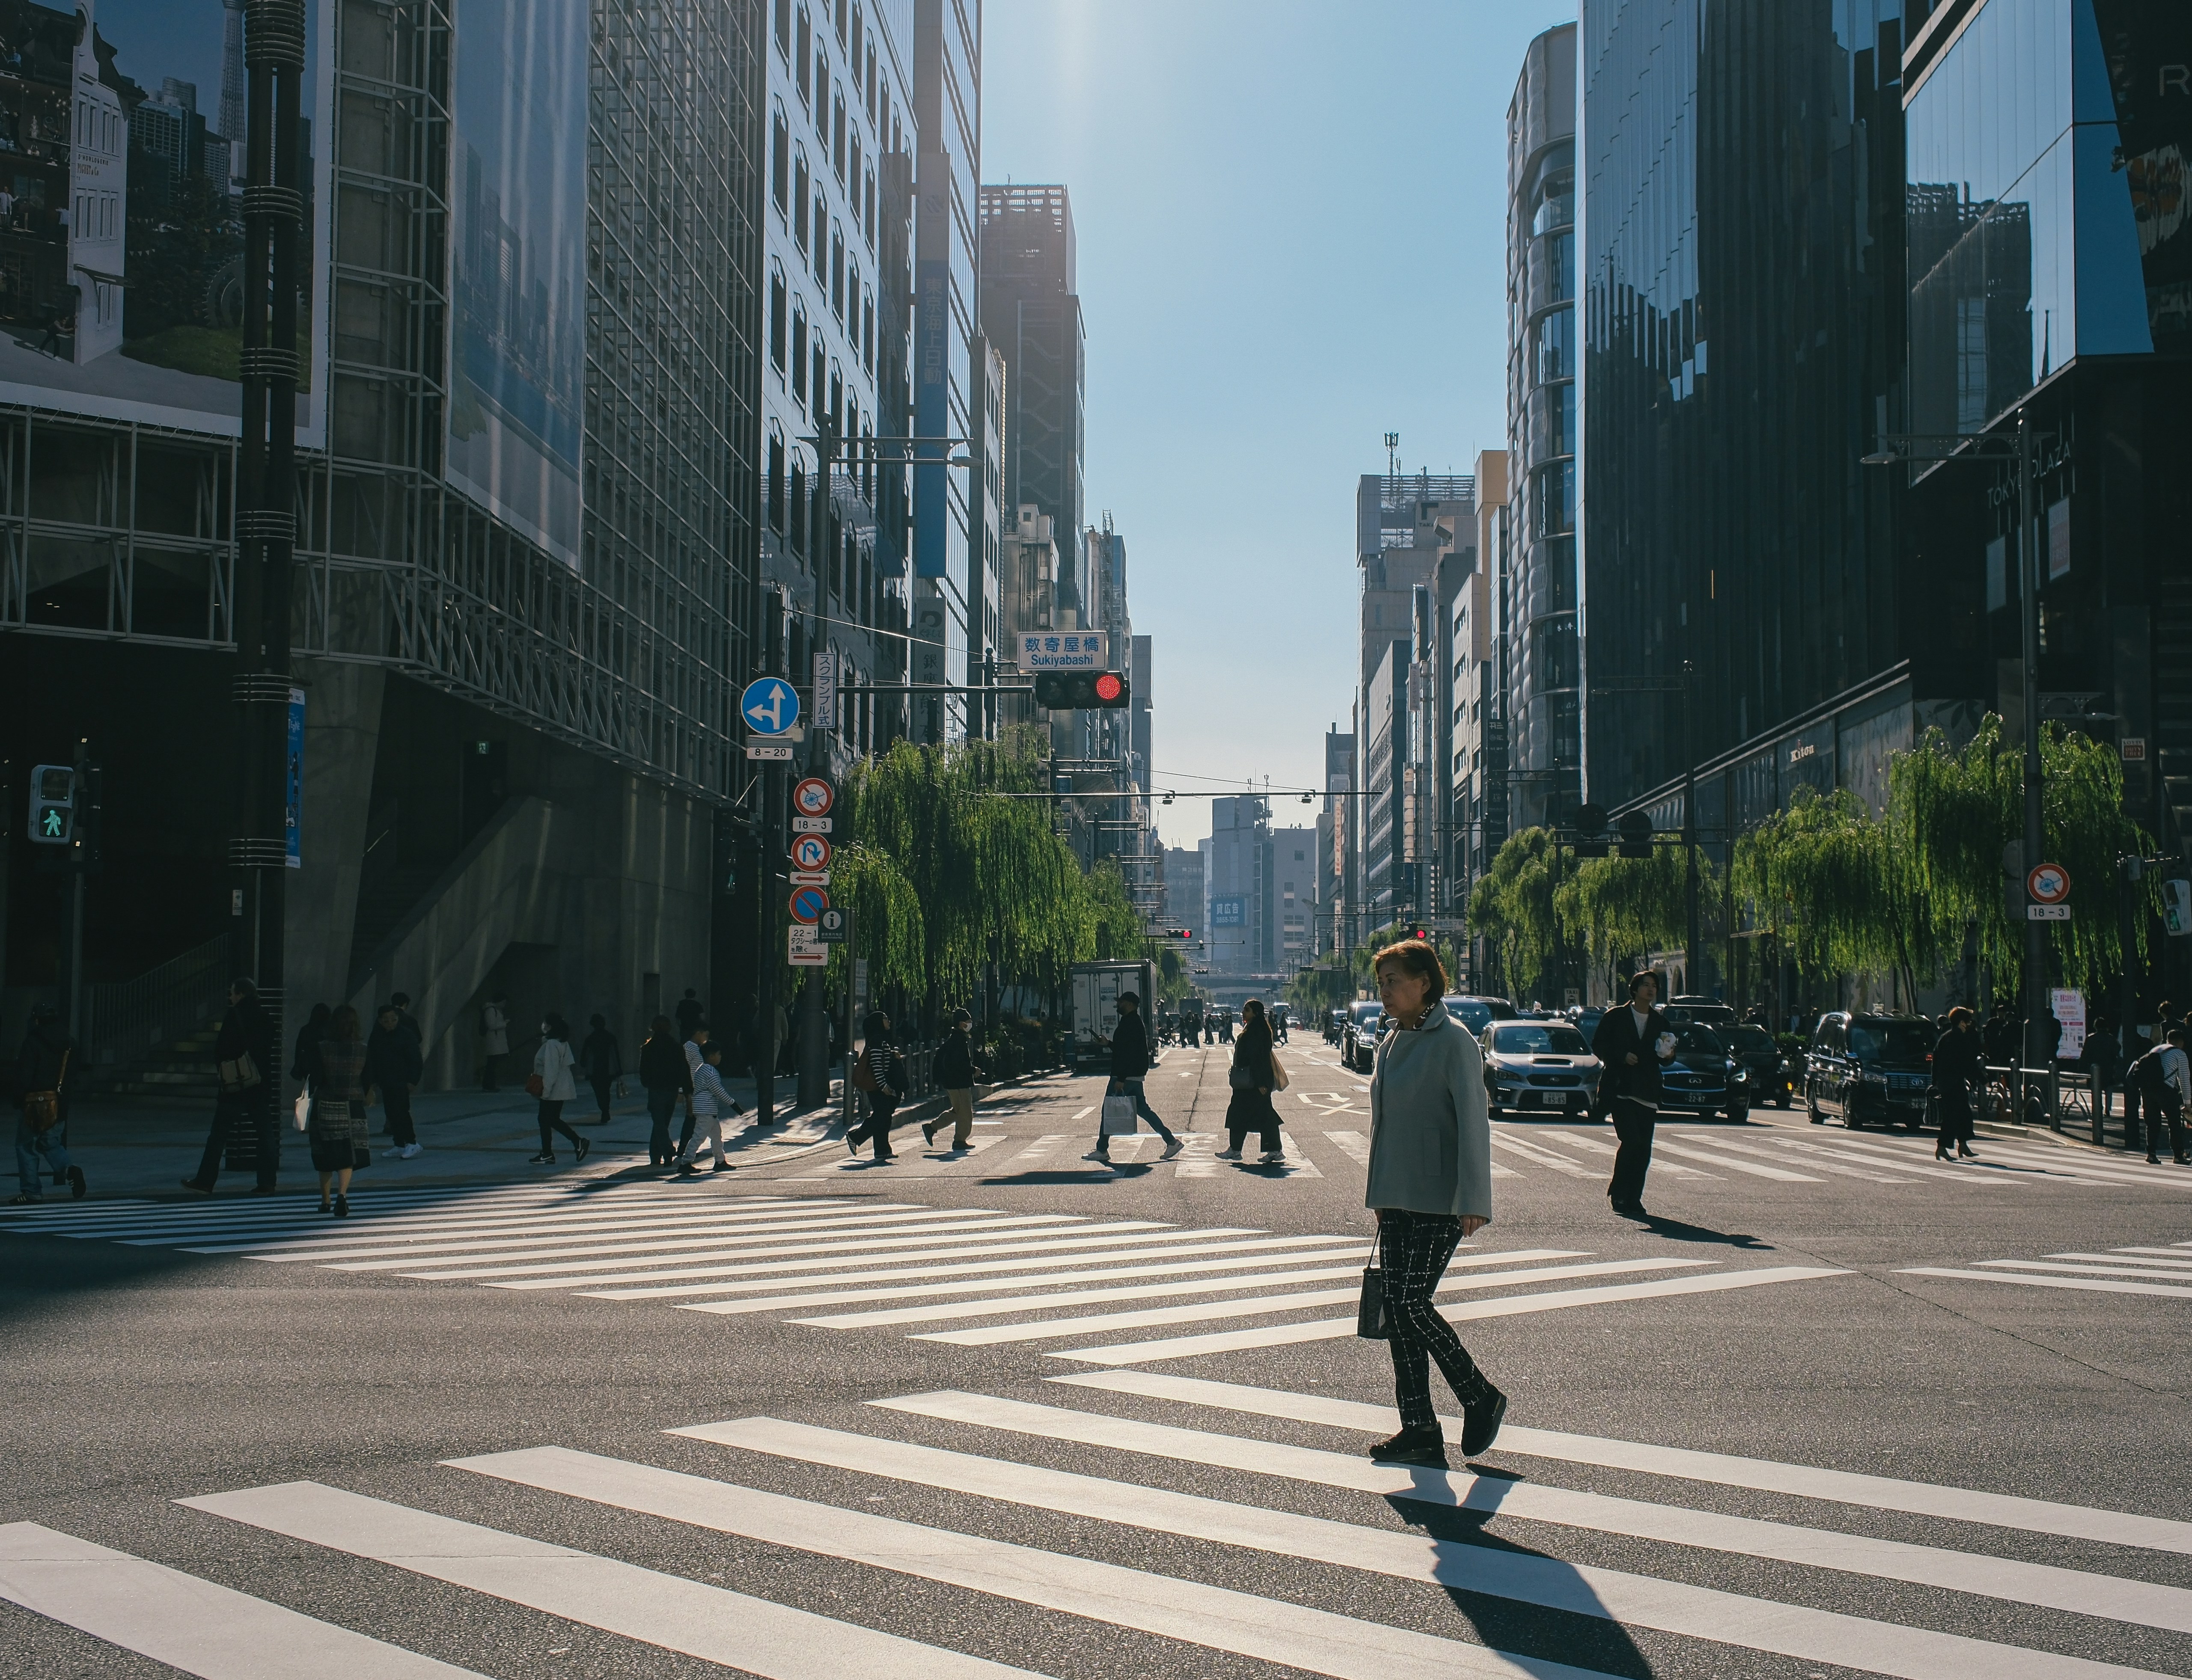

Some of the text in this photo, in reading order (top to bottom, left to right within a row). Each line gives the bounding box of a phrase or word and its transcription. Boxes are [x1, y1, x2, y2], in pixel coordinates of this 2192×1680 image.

[924, 278, 943, 385] 東京海上日動
[1025, 636, 1099, 653] 数寄屋橋
[1031, 654, 1093, 667] Sukiyabashi
[818, 656, 831, 725] スクランブル式
[1790, 740, 1814, 763] Kiton
[1216, 902, 1239, 914] 貸広告
